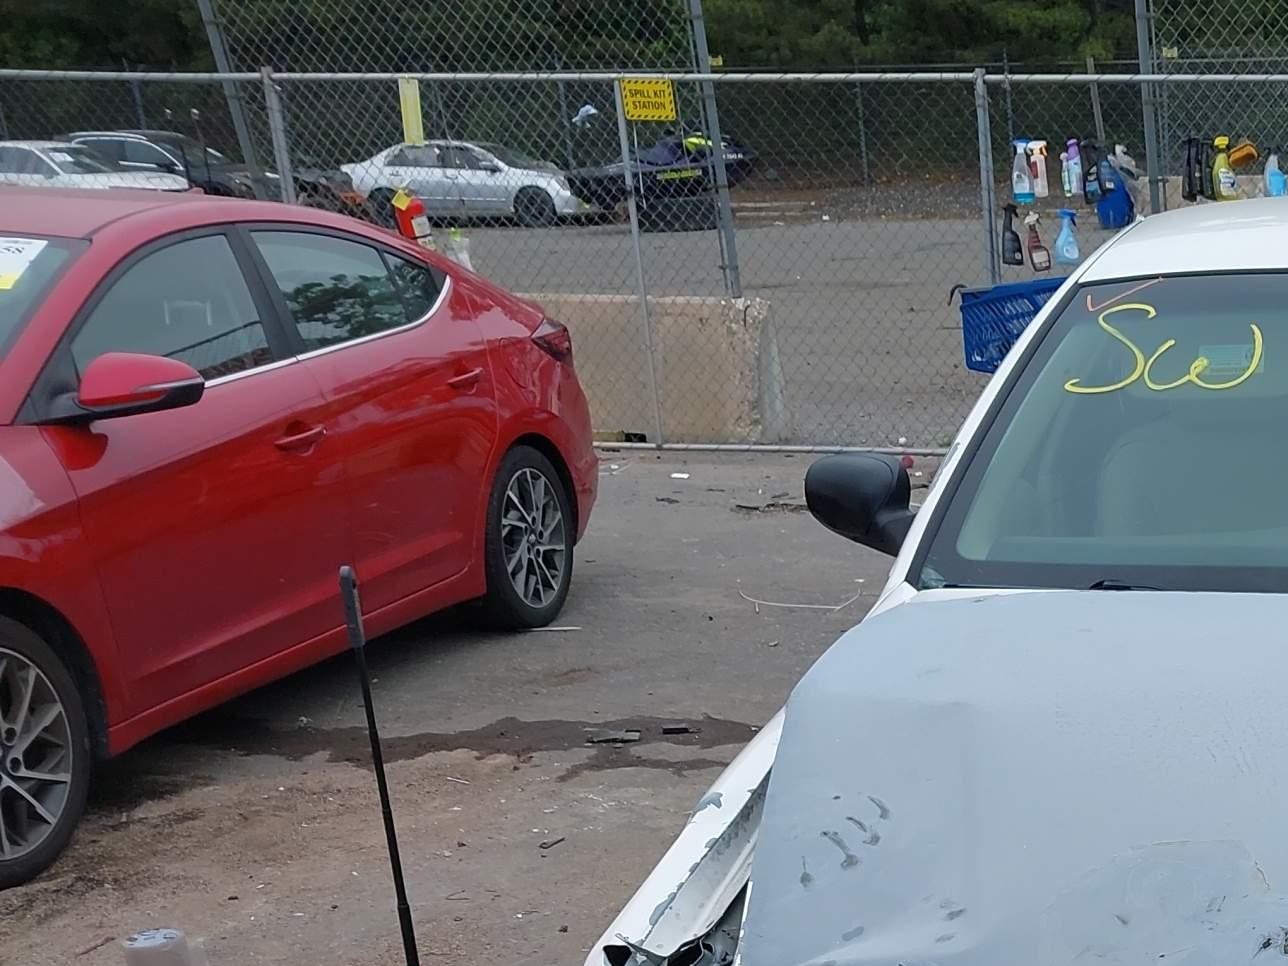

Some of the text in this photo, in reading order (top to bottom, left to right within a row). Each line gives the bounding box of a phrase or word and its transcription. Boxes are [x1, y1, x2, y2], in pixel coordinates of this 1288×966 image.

[628, 88, 667, 99] SPILL KIT
[631, 100, 667, 111] STATION
